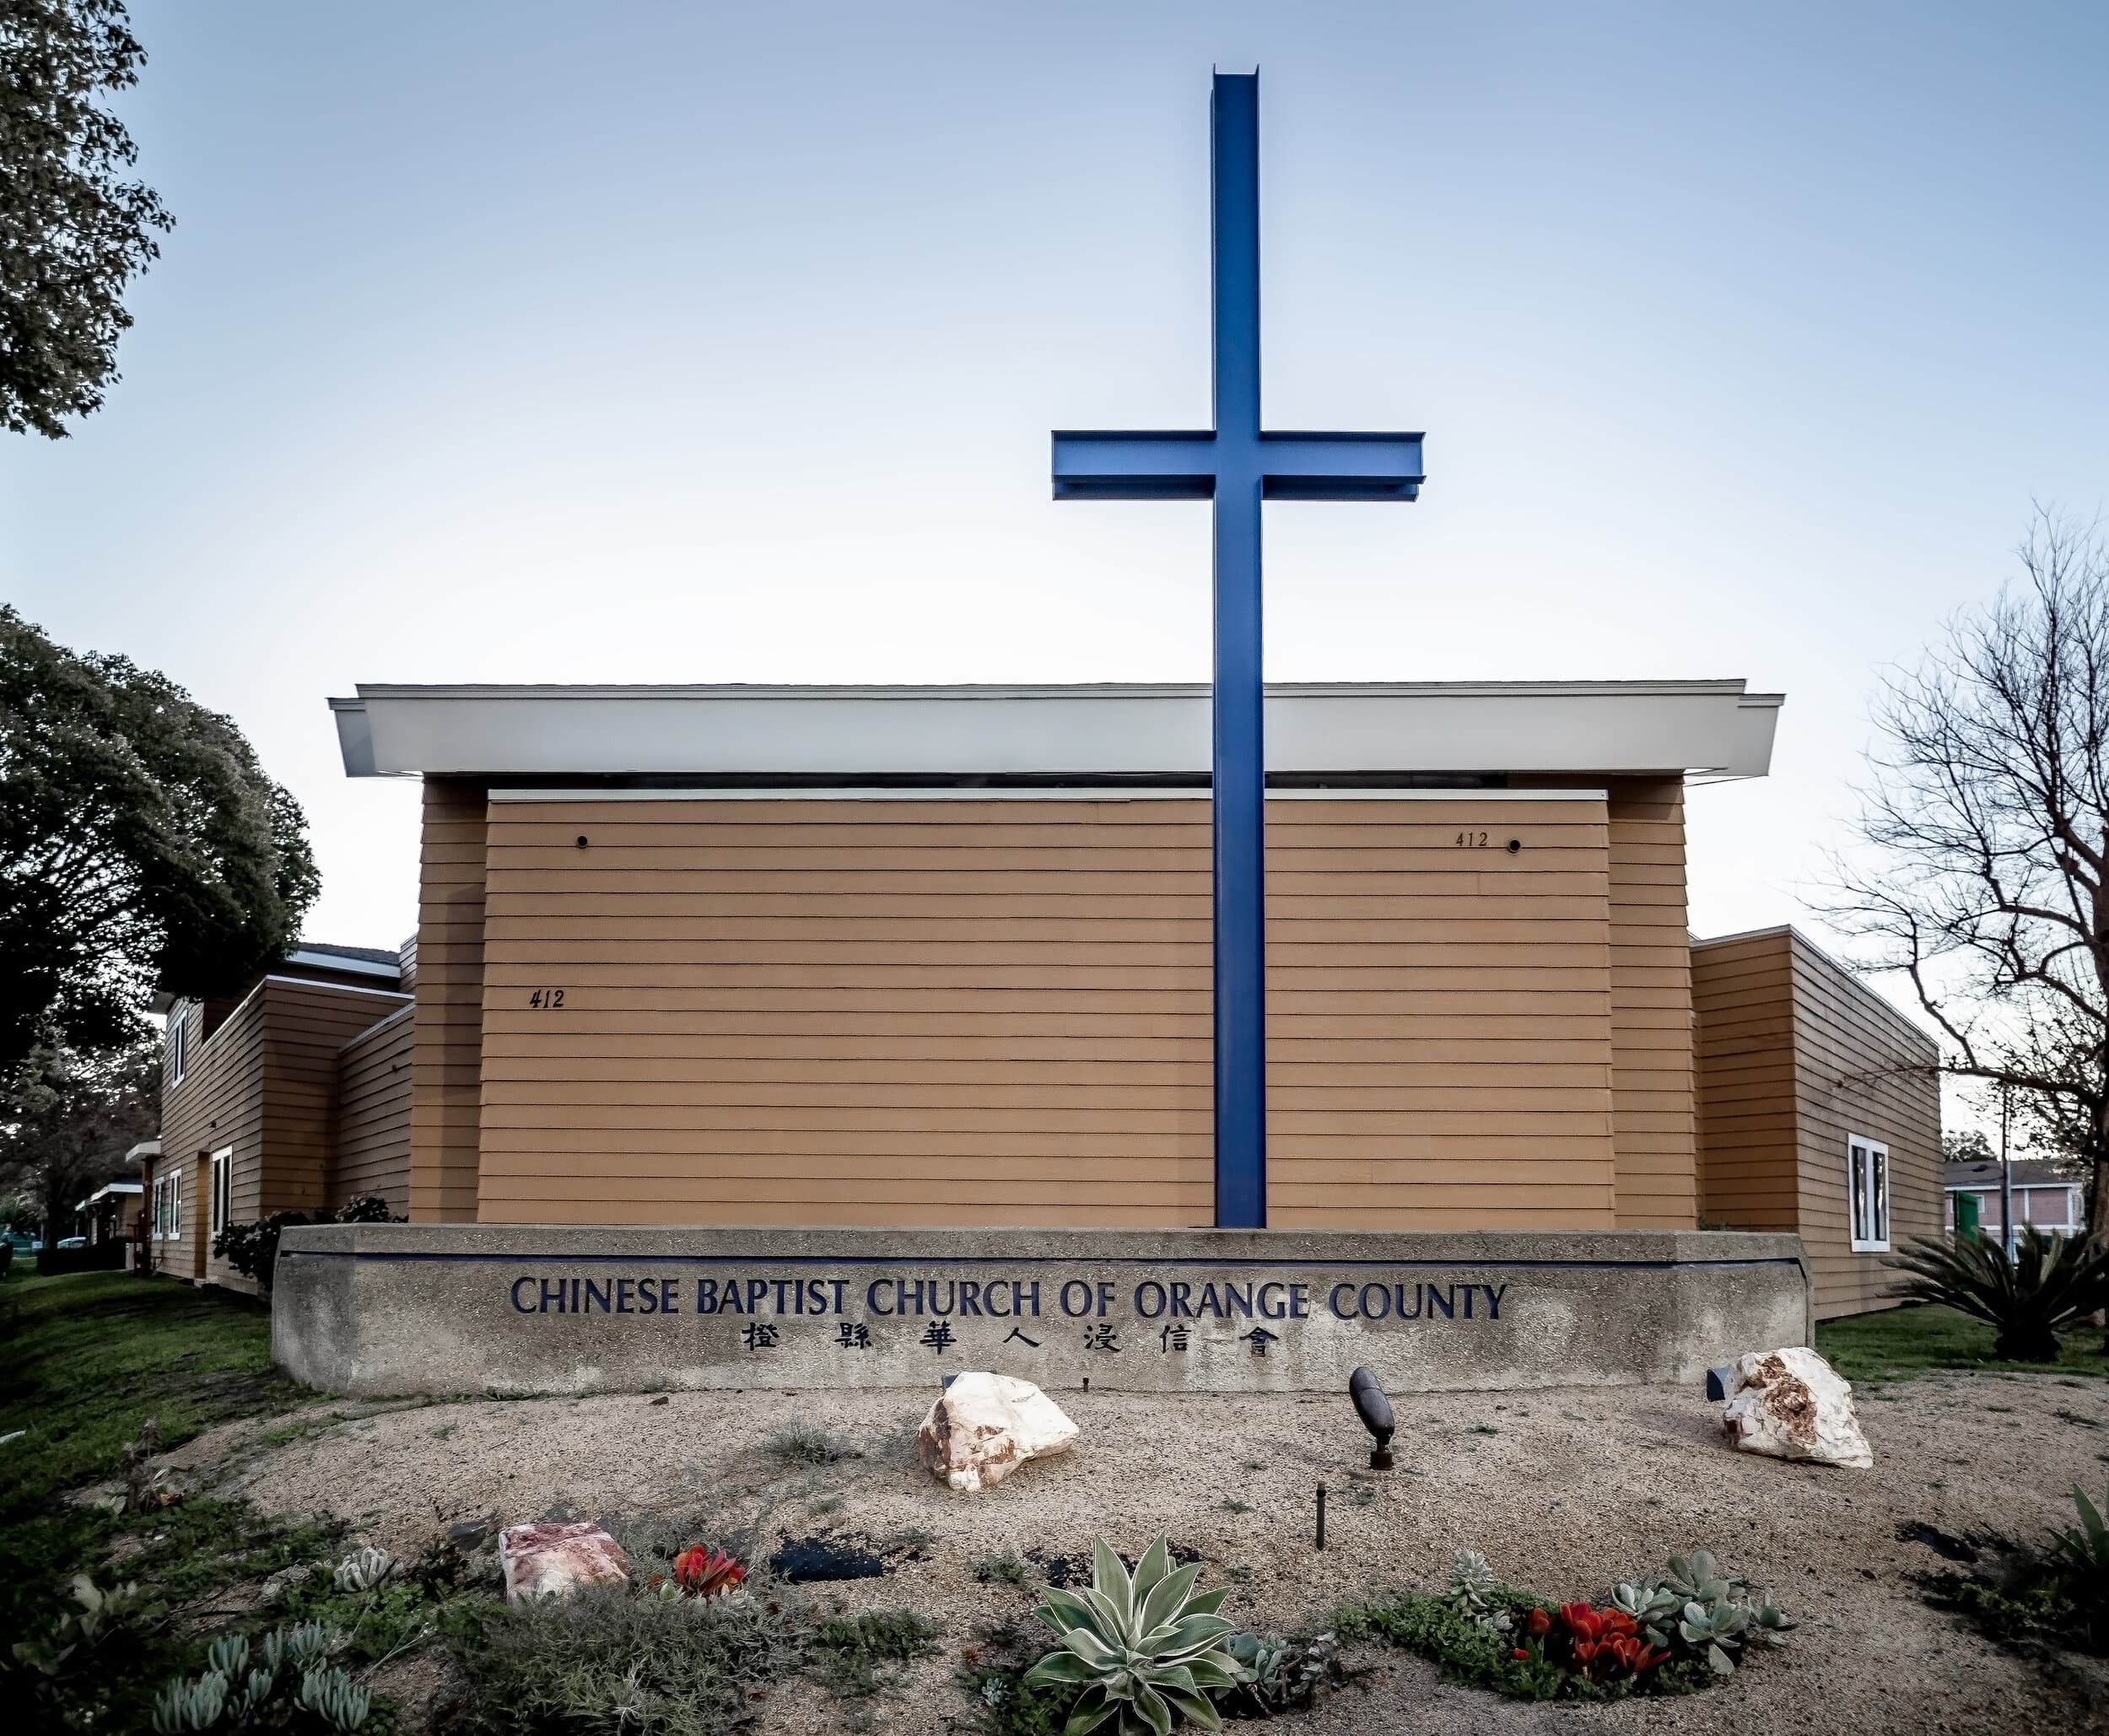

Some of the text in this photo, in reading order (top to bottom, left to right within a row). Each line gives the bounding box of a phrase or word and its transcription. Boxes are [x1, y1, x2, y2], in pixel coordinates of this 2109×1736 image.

[1456, 832, 1488, 847] 412
[530, 989, 564, 1008] 412
[510, 1276, 1508, 1320] CHINESE BAPTIST CHURCH OF ORANGE COUNTY
[741, 1321, 1280, 1357] 橙縣華人浸信會
